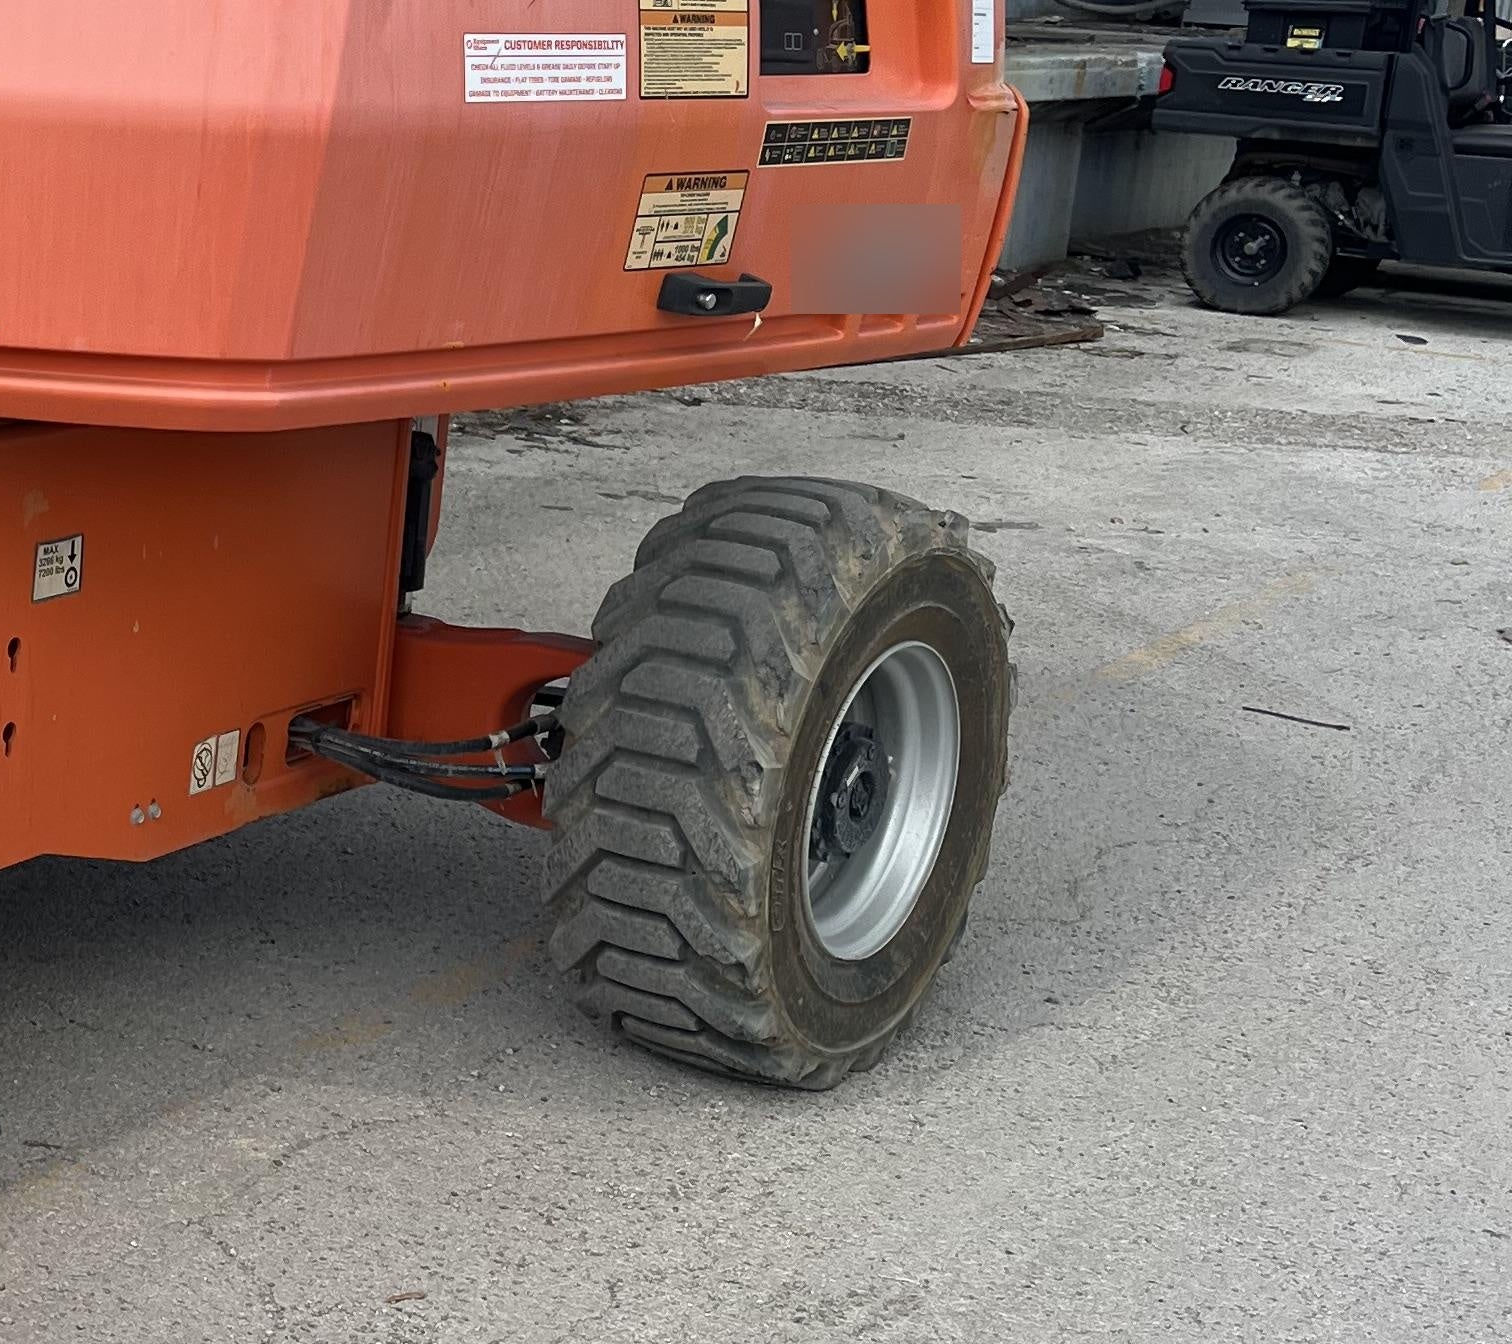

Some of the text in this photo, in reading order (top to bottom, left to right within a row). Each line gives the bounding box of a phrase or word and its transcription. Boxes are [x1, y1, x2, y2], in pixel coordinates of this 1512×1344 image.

[680, 14, 716, 24] WARNING
[504, 40, 625, 51] CUSTOMER RESPONSIBILITY
[1217, 77, 1345, 97] RANGER
[676, 176, 728, 190] WARNING
[43, 545, 59, 555] MAX
[38, 567, 54, 578] 7200
